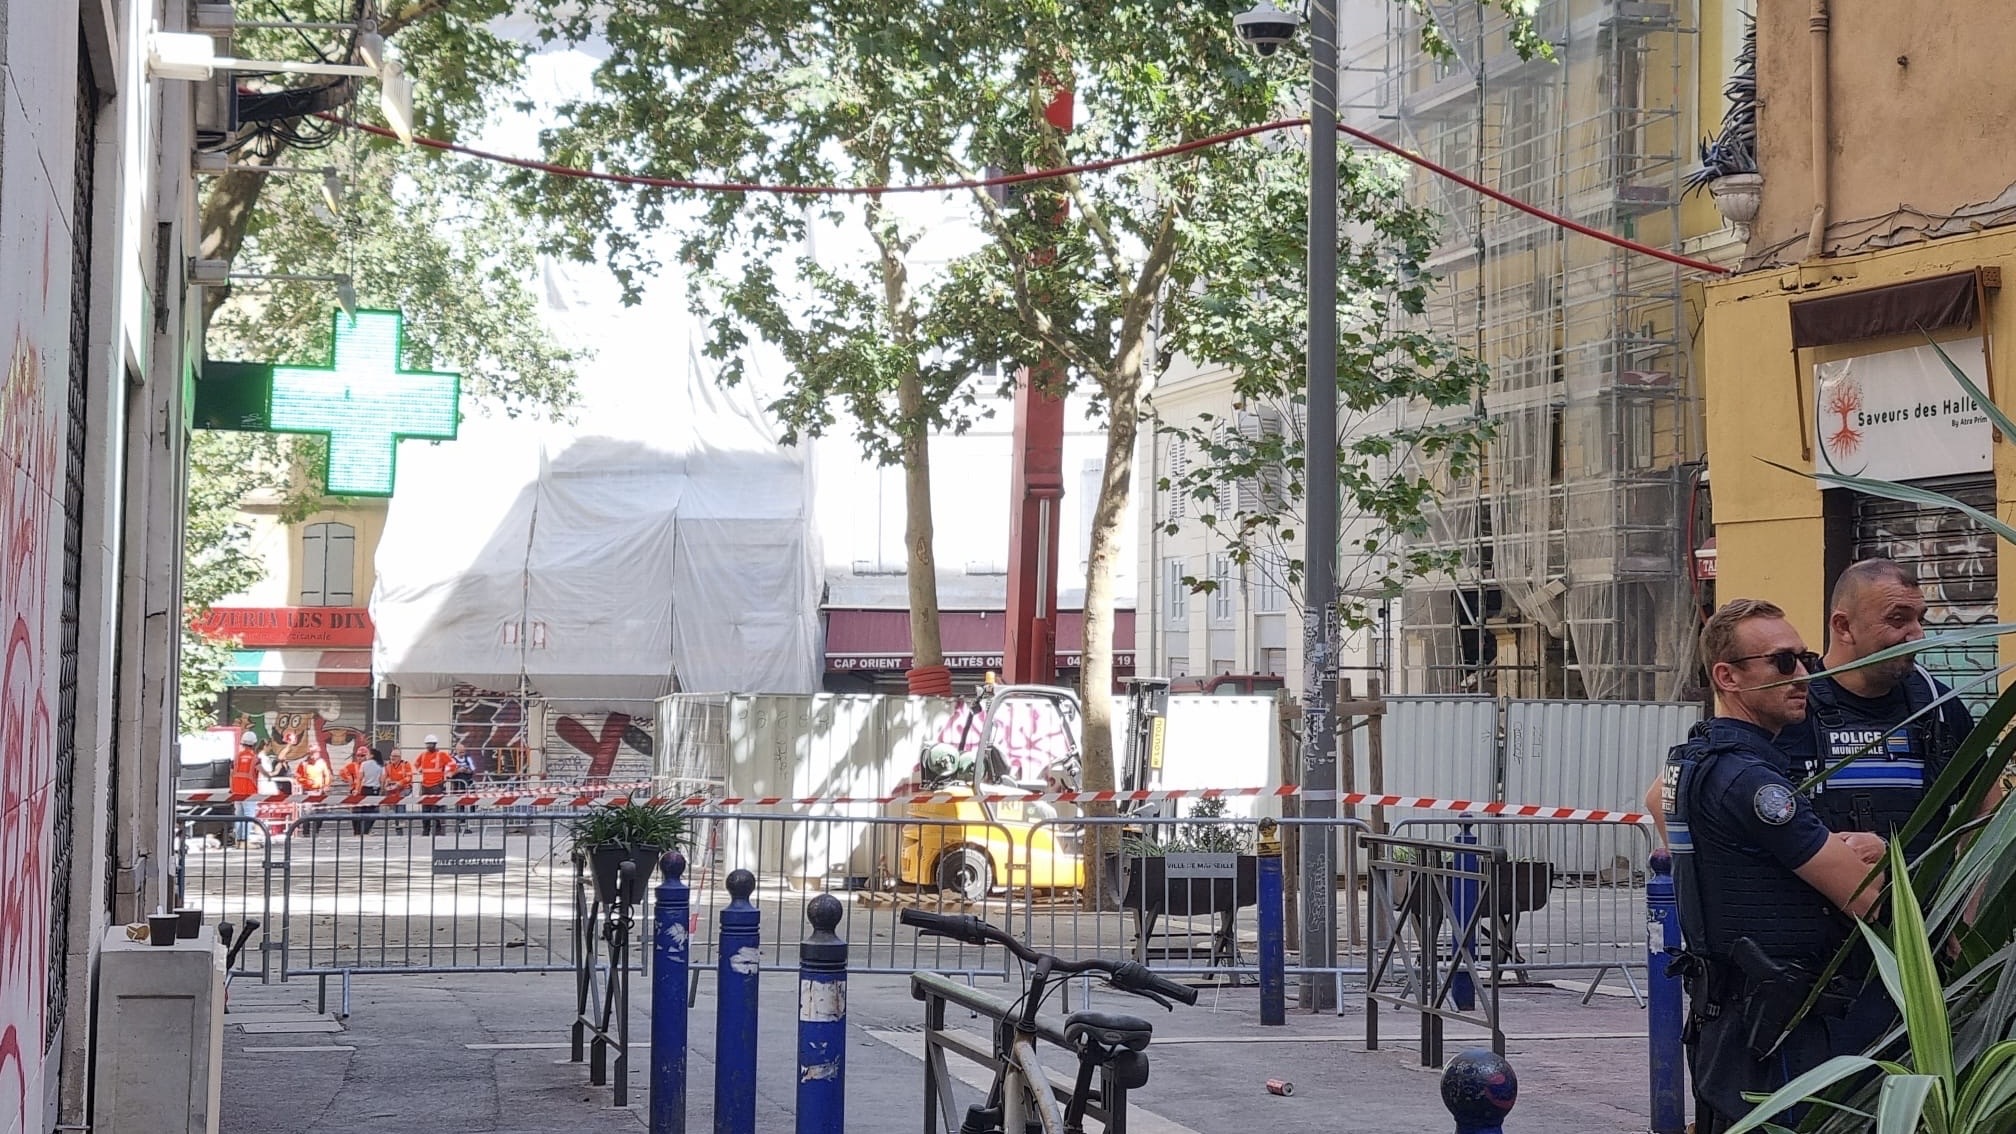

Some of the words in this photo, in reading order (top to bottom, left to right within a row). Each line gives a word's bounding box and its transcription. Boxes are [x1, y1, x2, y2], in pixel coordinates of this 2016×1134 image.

[1858, 408, 1909, 427] Saveurs
[1914, 402, 1937, 419] des
[1943, 396, 1978, 415] Halle
[1951, 419, 1959, 428] By
[288, 612, 322, 628] LES
[330, 612, 366, 629] DIX
[834, 658, 858, 669] CAP
[859, 658, 902, 669] ORIENT
[911, 655, 984, 668] ALITÉS
[986, 656, 1003, 667] OR
[1067, 656, 1081, 666] 04
[1829, 731, 1882, 744] POLICE
[1831, 746, 1884, 755] MUNICIALE
